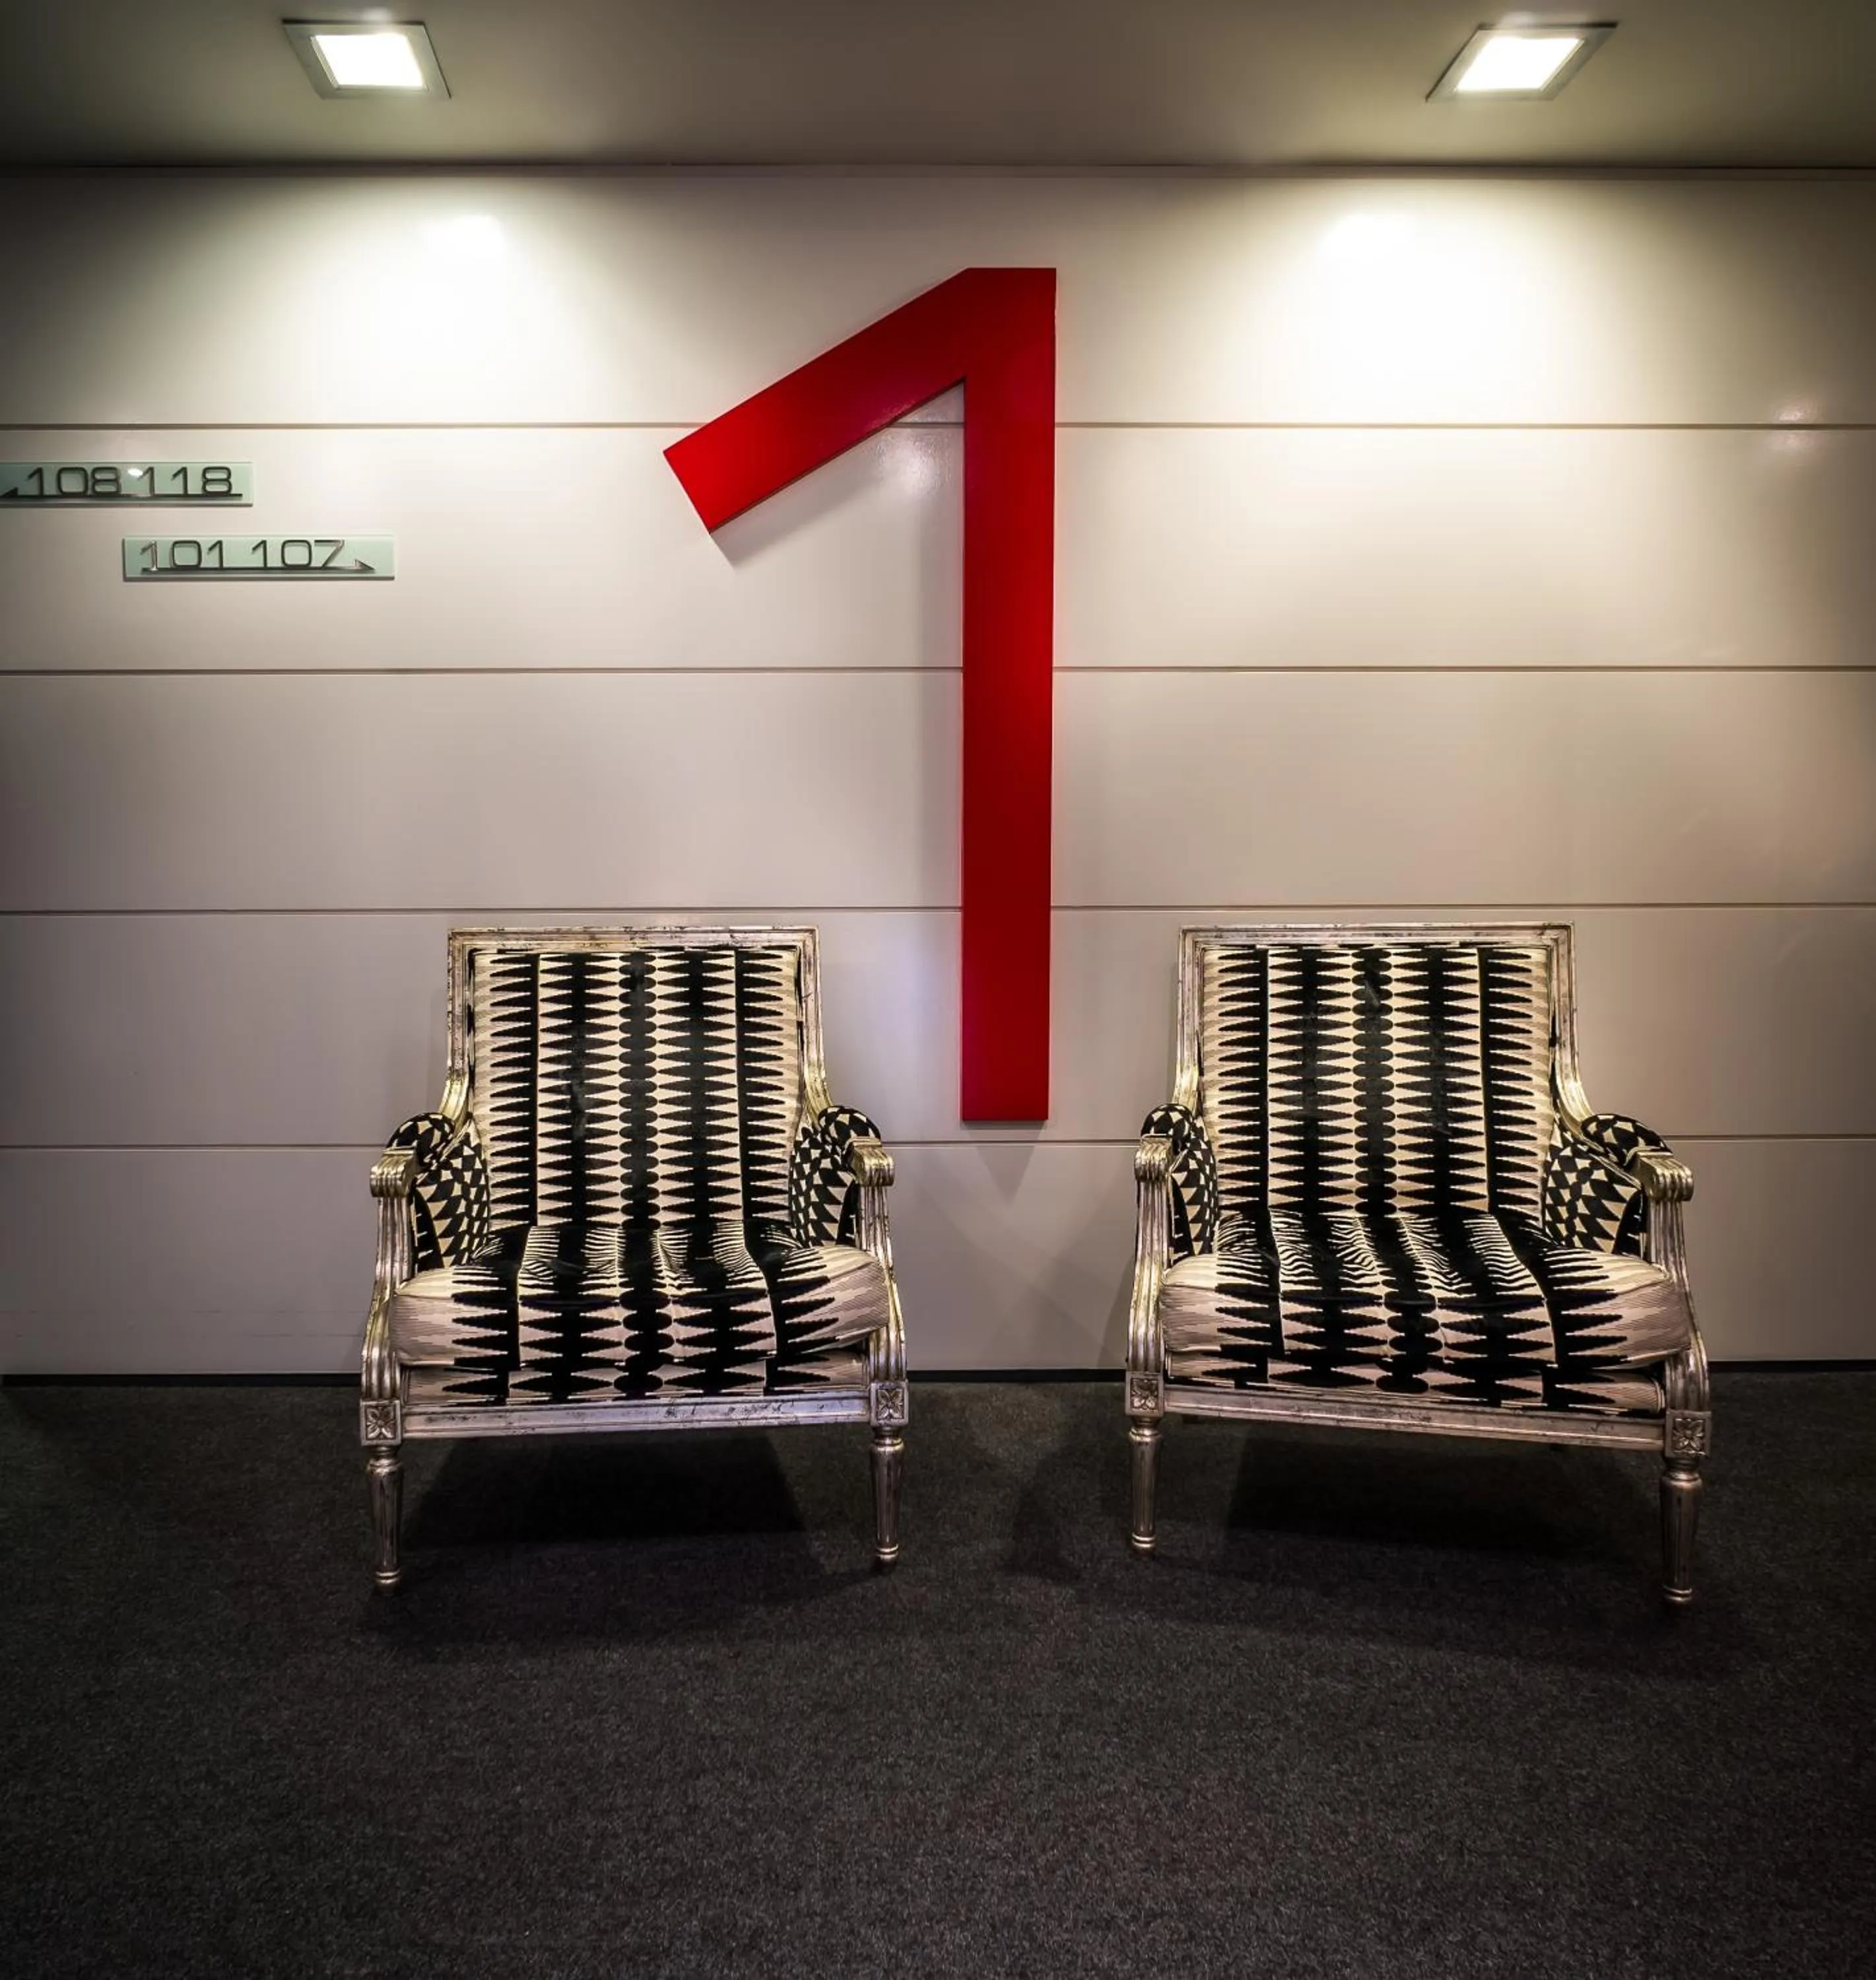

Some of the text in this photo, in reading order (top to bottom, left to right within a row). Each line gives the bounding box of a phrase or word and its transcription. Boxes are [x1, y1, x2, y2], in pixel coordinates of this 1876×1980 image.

[27, 466, 233, 496] 108 118
[139, 539, 345, 570] 101 107
[664, 267, 1056, 1121] 1
